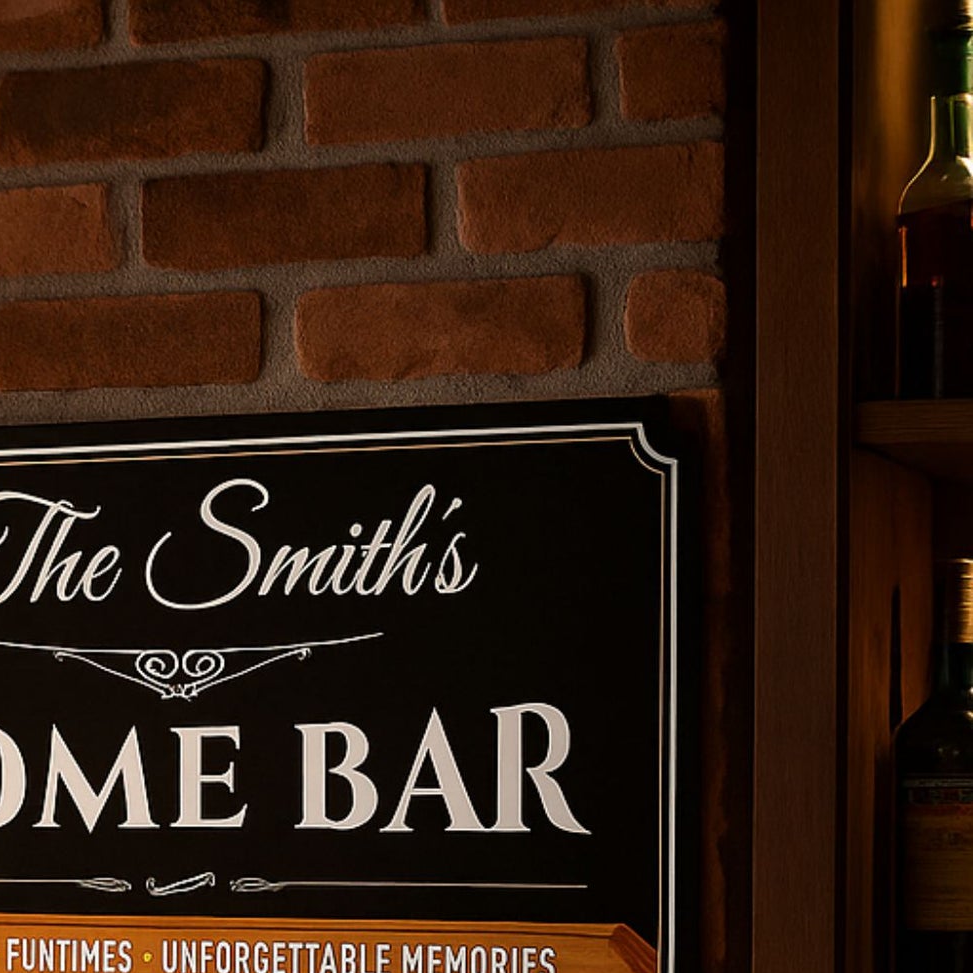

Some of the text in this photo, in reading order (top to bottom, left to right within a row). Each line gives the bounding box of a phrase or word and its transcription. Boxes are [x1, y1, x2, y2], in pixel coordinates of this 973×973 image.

[145, 478, 479, 610] Smith's
[293, 702, 592, 835] BAR
[6, 938, 132, 973] FUNTIMES
